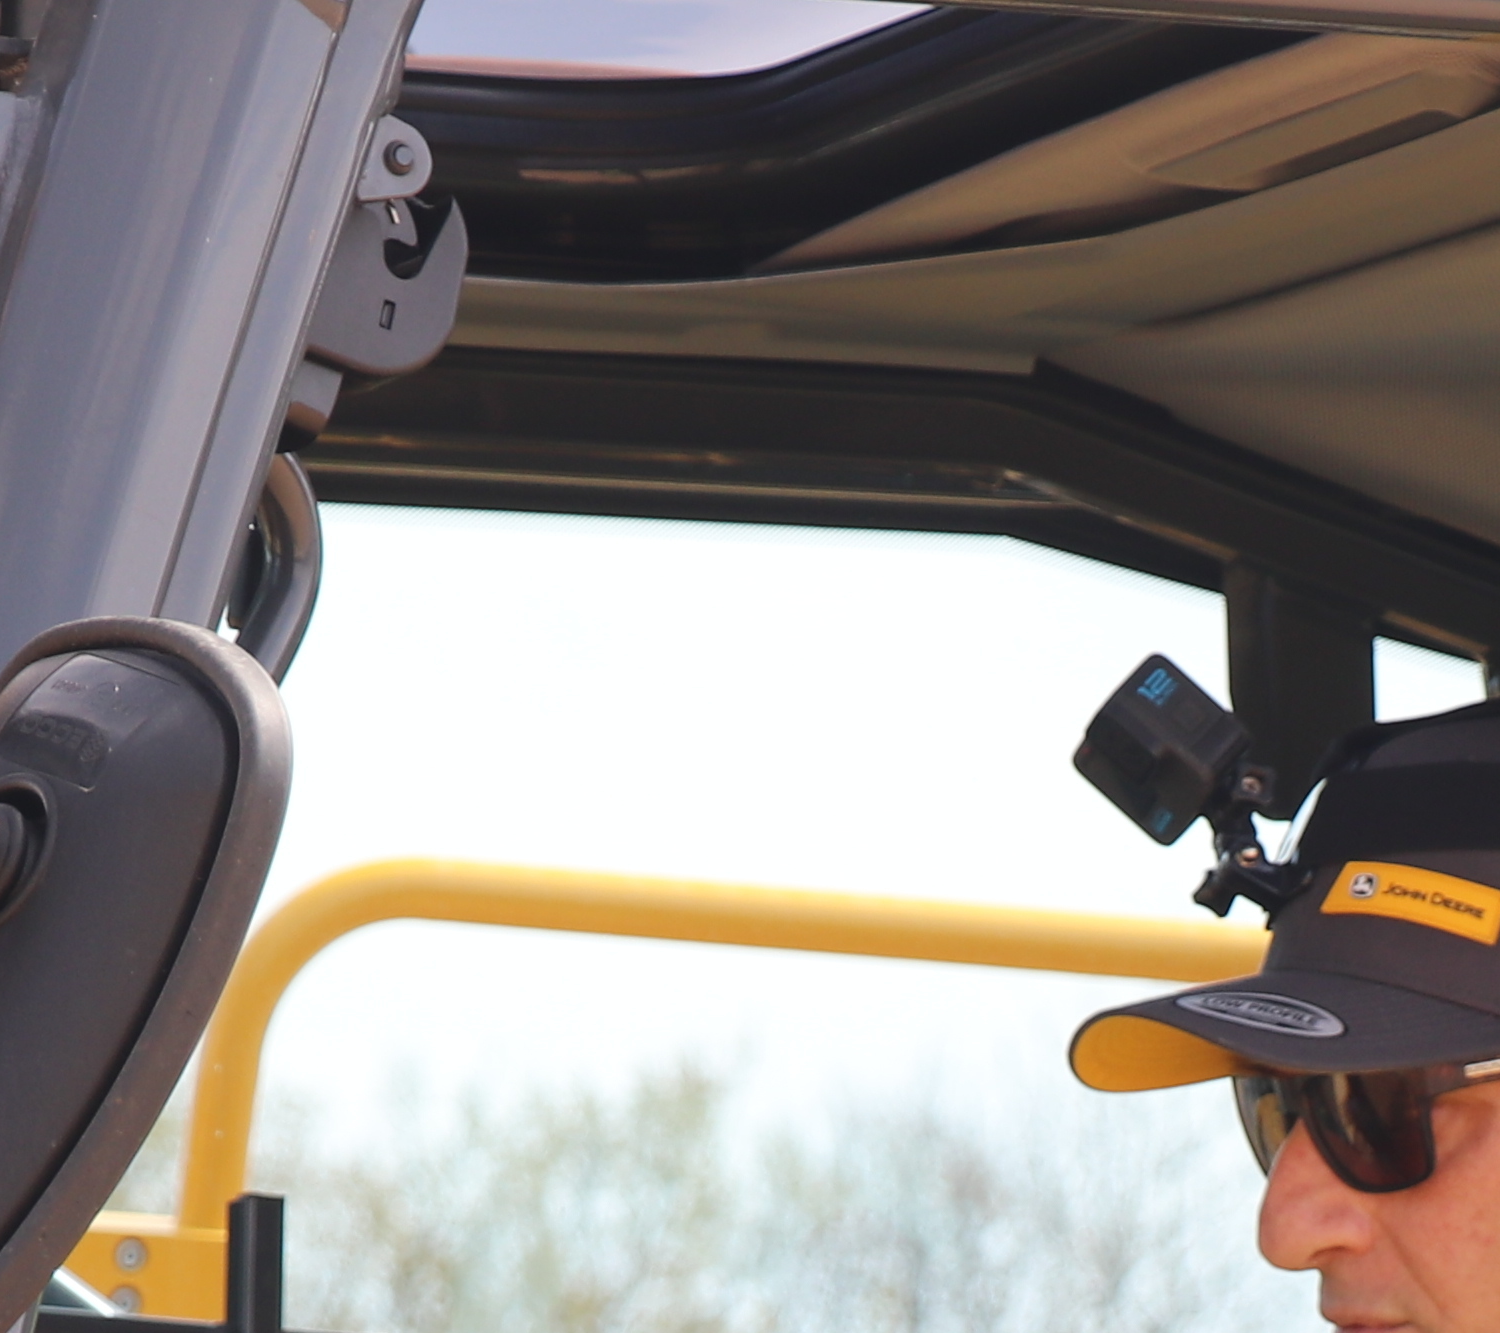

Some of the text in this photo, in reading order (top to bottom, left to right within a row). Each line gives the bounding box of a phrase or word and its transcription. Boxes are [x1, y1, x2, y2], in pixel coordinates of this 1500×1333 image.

[1382, 882, 1486, 921] JOHN DEERE
[1202, 996, 1315, 1027] LOW PROFILE
